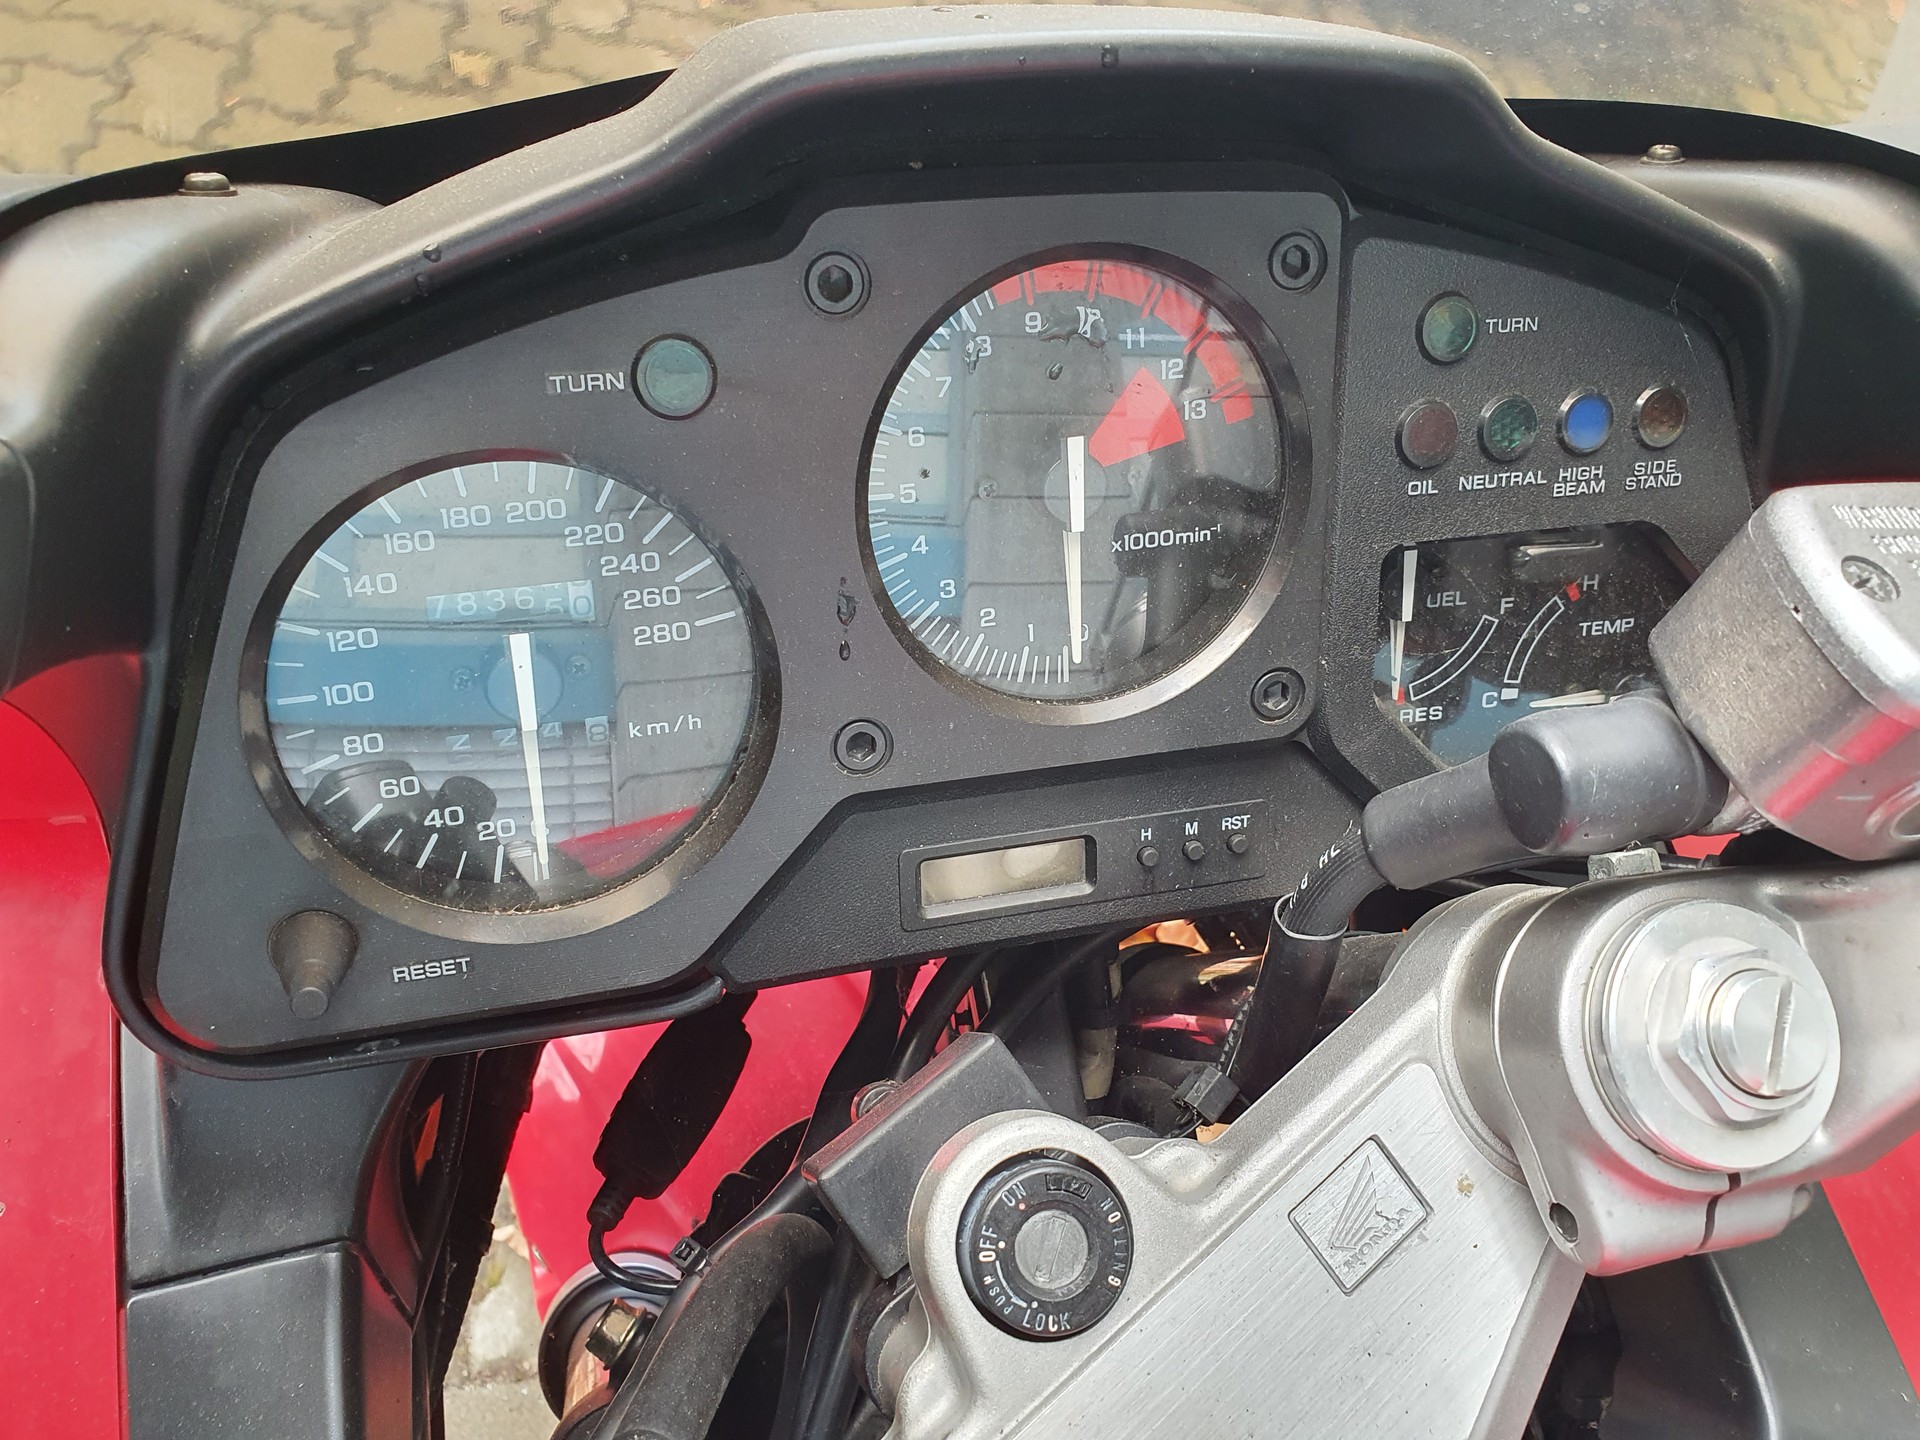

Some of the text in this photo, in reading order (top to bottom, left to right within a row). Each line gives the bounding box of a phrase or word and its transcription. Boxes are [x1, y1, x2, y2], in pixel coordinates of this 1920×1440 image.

[1025, 311, 1042, 333] 9
[1485, 316, 1539, 335] TURN
[1126, 327, 1145, 348] 11
[1160, 358, 1184, 380] 12
[549, 371, 625, 393] TURN
[935, 376, 953, 398] 7
[1184, 399, 1207, 421] 13
[908, 427, 925, 447] 6
[1558, 465, 1604, 482] HIGH
[1634, 459, 1678, 476] SIDE
[1407, 480, 1439, 496] OIL
[1458, 470, 1548, 491] NEUTRAL
[1552, 480, 1606, 498] BEAM
[1625, 473, 1682, 491] STAND
[899, 483, 916, 503] 5
[440, 505, 492, 529] 180
[505, 499, 568, 523] 200
[384, 529, 436, 556] 160
[564, 522, 626, 548] 220
[911, 534, 929, 555] 4
[600, 552, 661, 577] 240
[343, 572, 399, 598] 140
[939, 579, 956, 599] 3
[1582, 573, 1599, 591] H
[623, 585, 682, 611] 260
[1427, 591, 1467, 608] UEL
[1500, 597, 1514, 615] F
[979, 607, 996, 628] 2
[1579, 617, 1635, 637] TEMP
[326, 628, 379, 653] 120
[633, 621, 692, 646] 280
[1026, 623, 1035, 643] 1
[322, 680, 375, 705] 100
[1481, 692, 1498, 708] C
[1399, 706, 1443, 723] RES
[628, 714, 702, 738] km/h
[343, 732, 384, 756] 80
[379, 776, 421, 799] 60
[423, 805, 465, 830] 40
[1185, 821, 1198, 835] M
[1221, 814, 1251, 831] RST
[477, 818, 517, 841] 20
[1140, 827, 1152, 841] H
[392, 957, 471, 982] RESET
[1002, 1181, 1027, 1206] ON
[978, 1225, 998, 1263] OFF
[983, 1275, 1014, 1315] PUSH
[1022, 1308, 1071, 1333] LOCK
